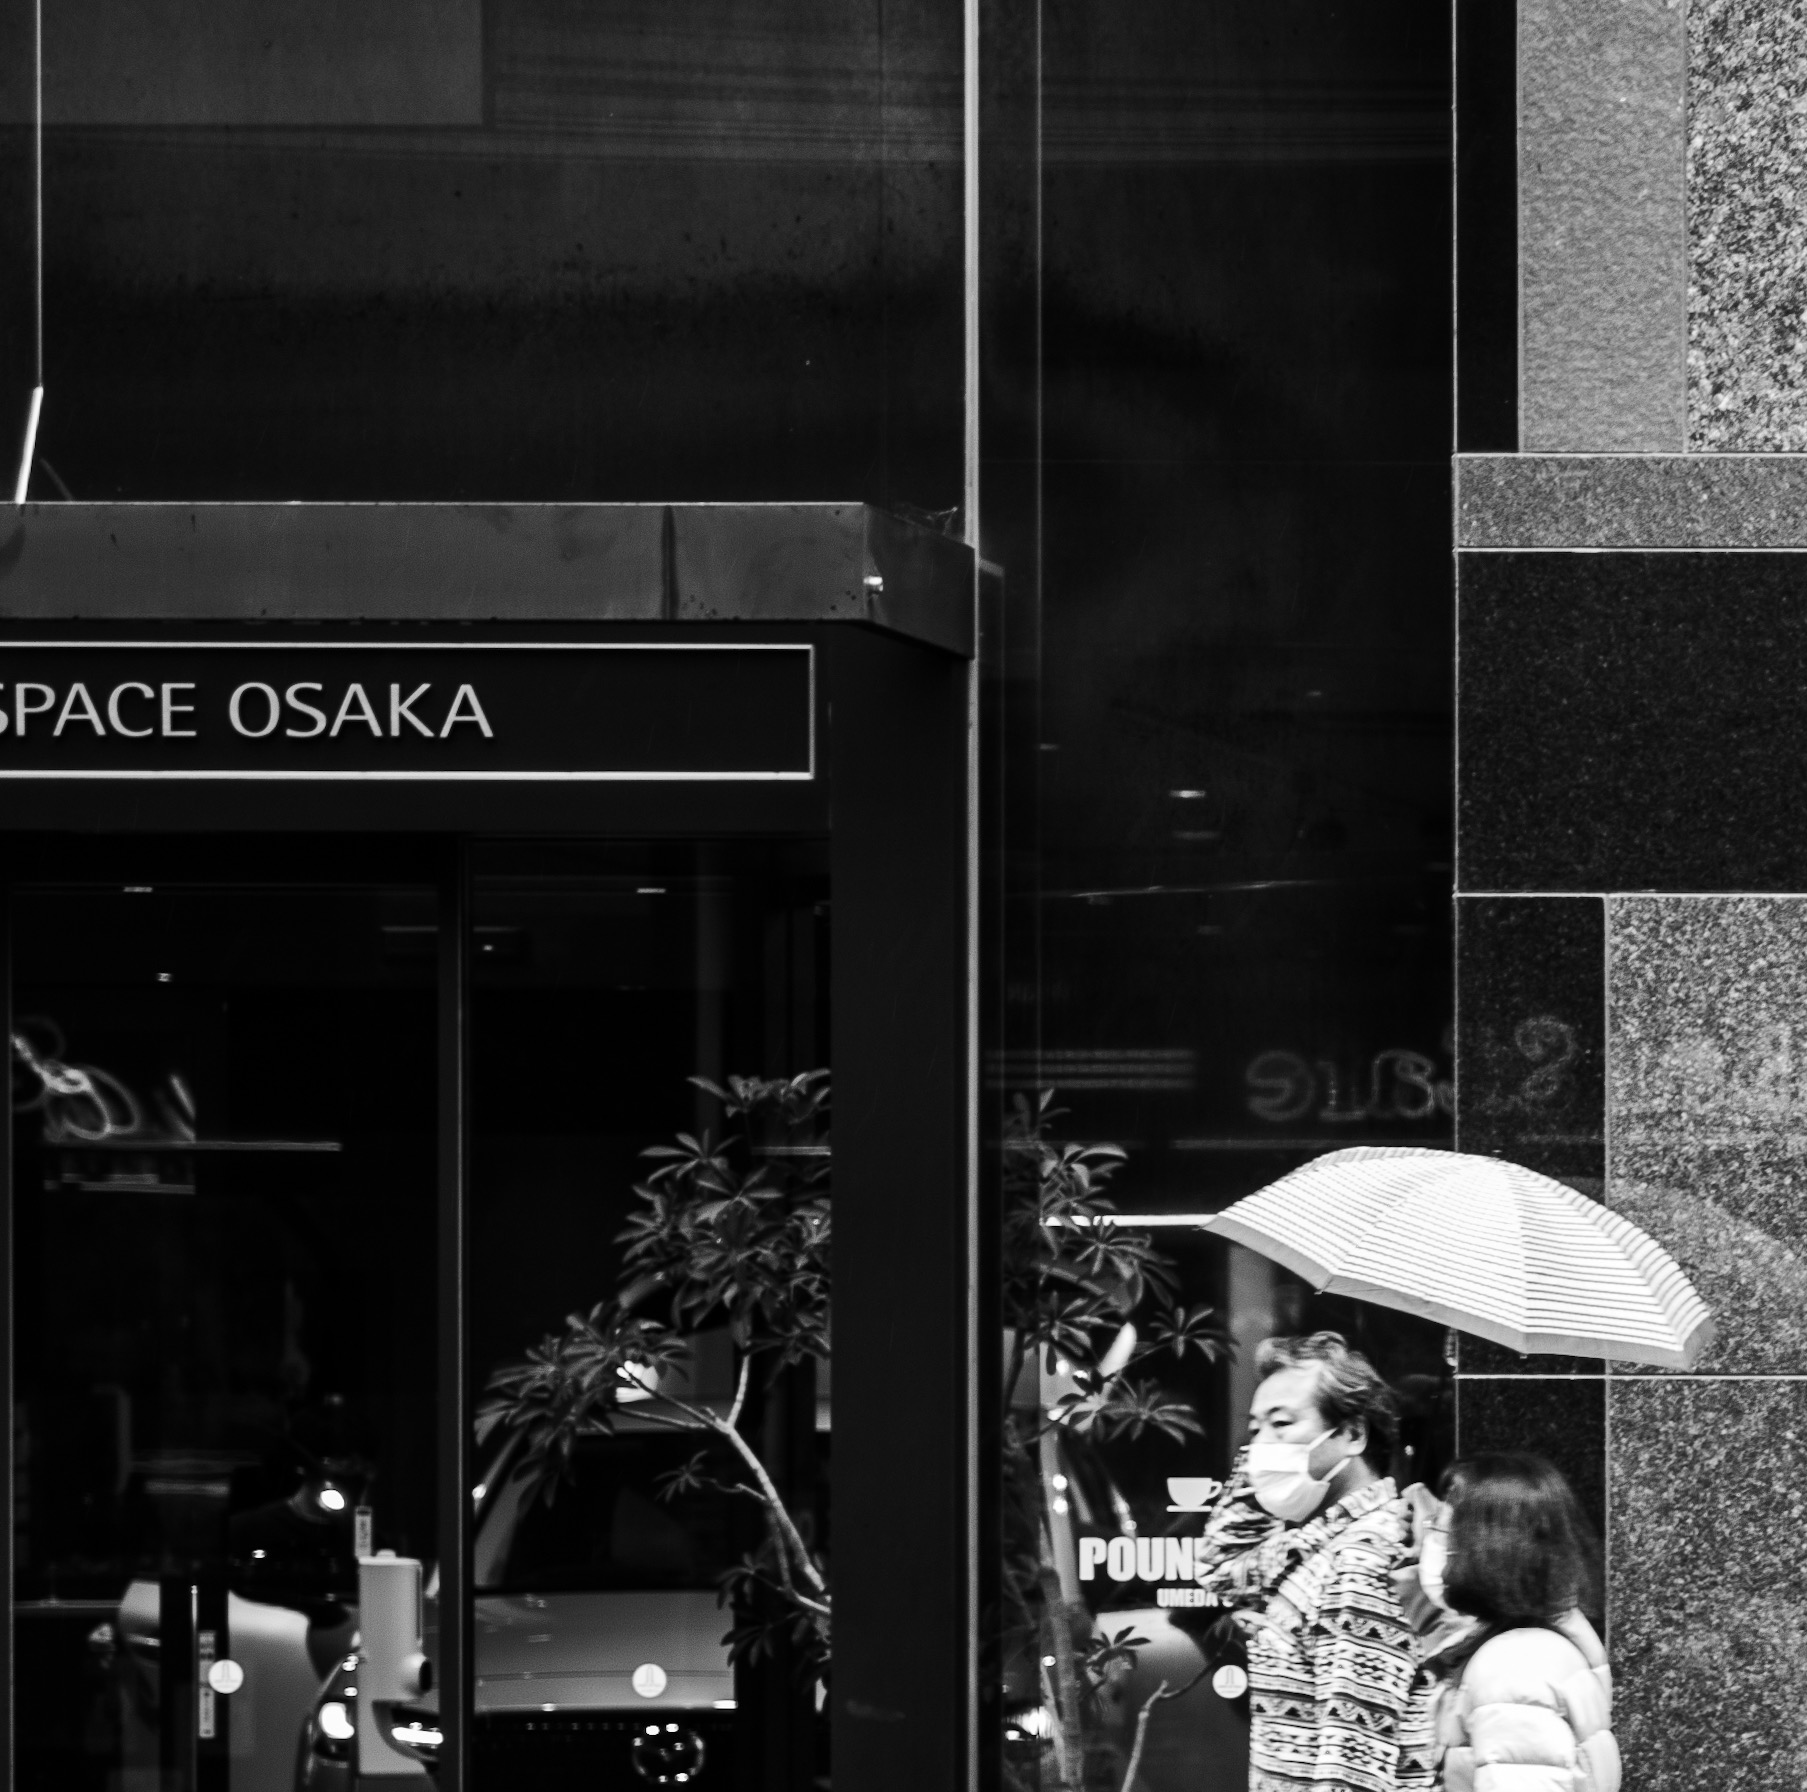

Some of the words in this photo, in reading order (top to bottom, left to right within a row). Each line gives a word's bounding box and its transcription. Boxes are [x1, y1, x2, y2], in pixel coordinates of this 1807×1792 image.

[0, 681, 198, 738] PACE
[227, 681, 495, 738] OSAKA
[1079, 1535, 1205, 1582] POUN
